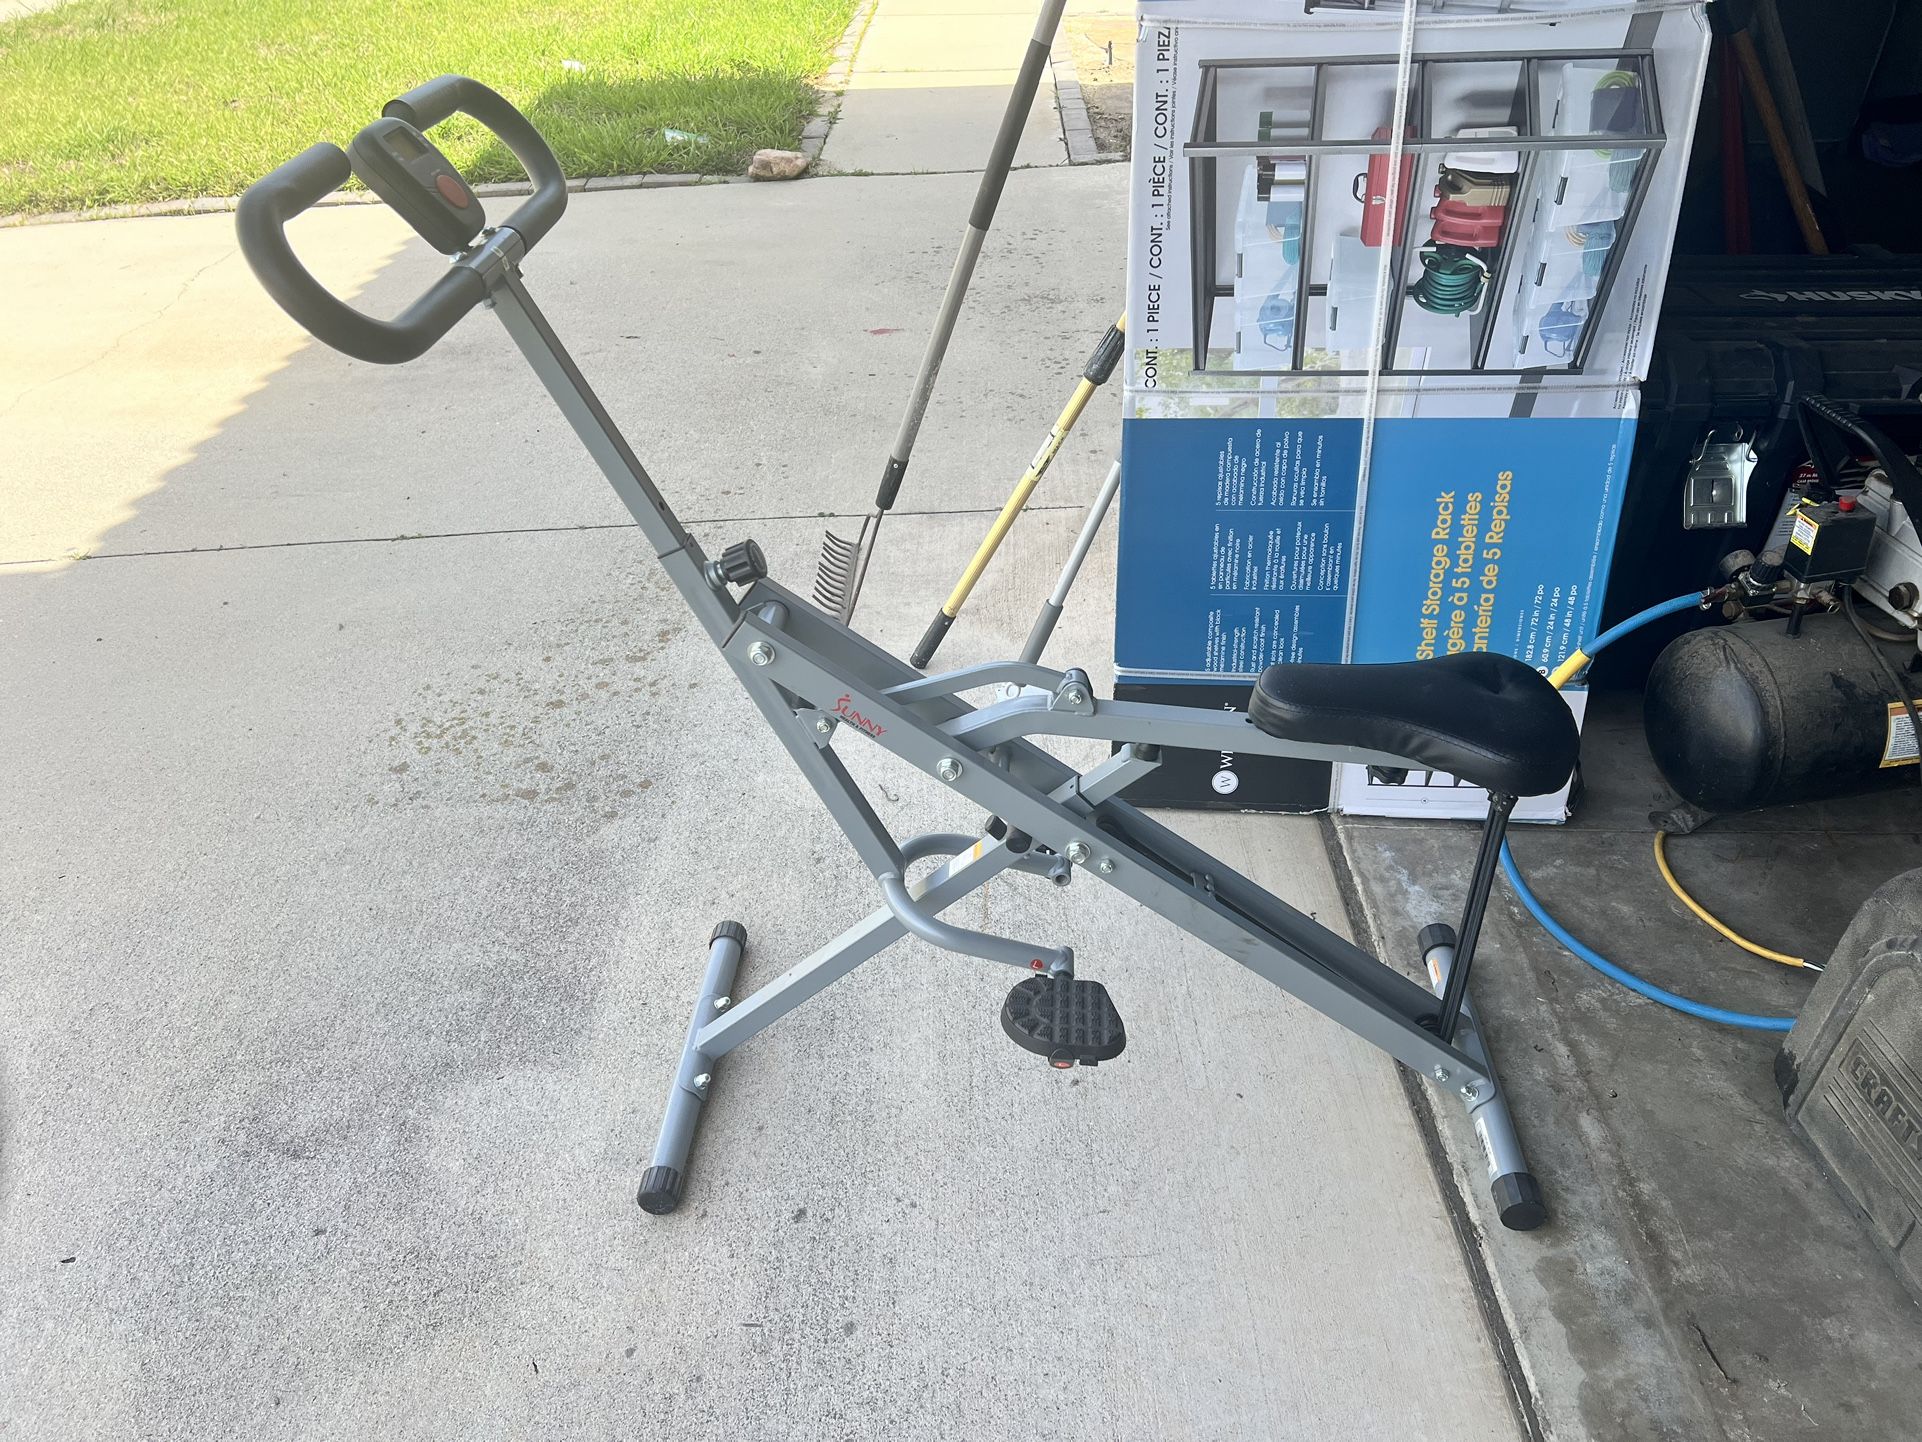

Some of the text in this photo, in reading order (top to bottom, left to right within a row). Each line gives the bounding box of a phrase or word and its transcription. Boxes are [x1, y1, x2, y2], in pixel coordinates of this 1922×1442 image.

[1155, 89, 1168, 138] CONT.
[1148, 156, 1165, 196] PIÈCE
[1150, 223, 1162, 268] CONT.
[1148, 285, 1160, 322] PIECE
[1145, 347, 1157, 387] CONT.
[1485, 471, 1512, 542] Repisas
[1431, 491, 1455, 539] Rack
[1456, 492, 1482, 572] tablettes
[1483, 548, 1500, 559] 5
[1422, 544, 1450, 614] Storage
[1452, 577, 1469, 587] 5
[1480, 563, 1498, 588] de
[1537, 585, 1544, 594] po
[1554, 587, 1560, 597] po
[1571, 585, 1577, 595] po
[1448, 592, 1467, 604] à
[1568, 597, 1575, 605] 48
[1547, 621, 1554, 629] 24
[1564, 619, 1571, 627] 48
[1529, 632, 1536, 643] cm
[1545, 636, 1551, 647] cm
[1562, 633, 1568, 644] cm
[1525, 645, 1534, 661] 182.8
[1558, 646, 1566, 662] 121.9
[831, 694, 888, 736] SUNNY
[1220, 775, 1231, 788] W
[1032, 960, 1038, 969] L
